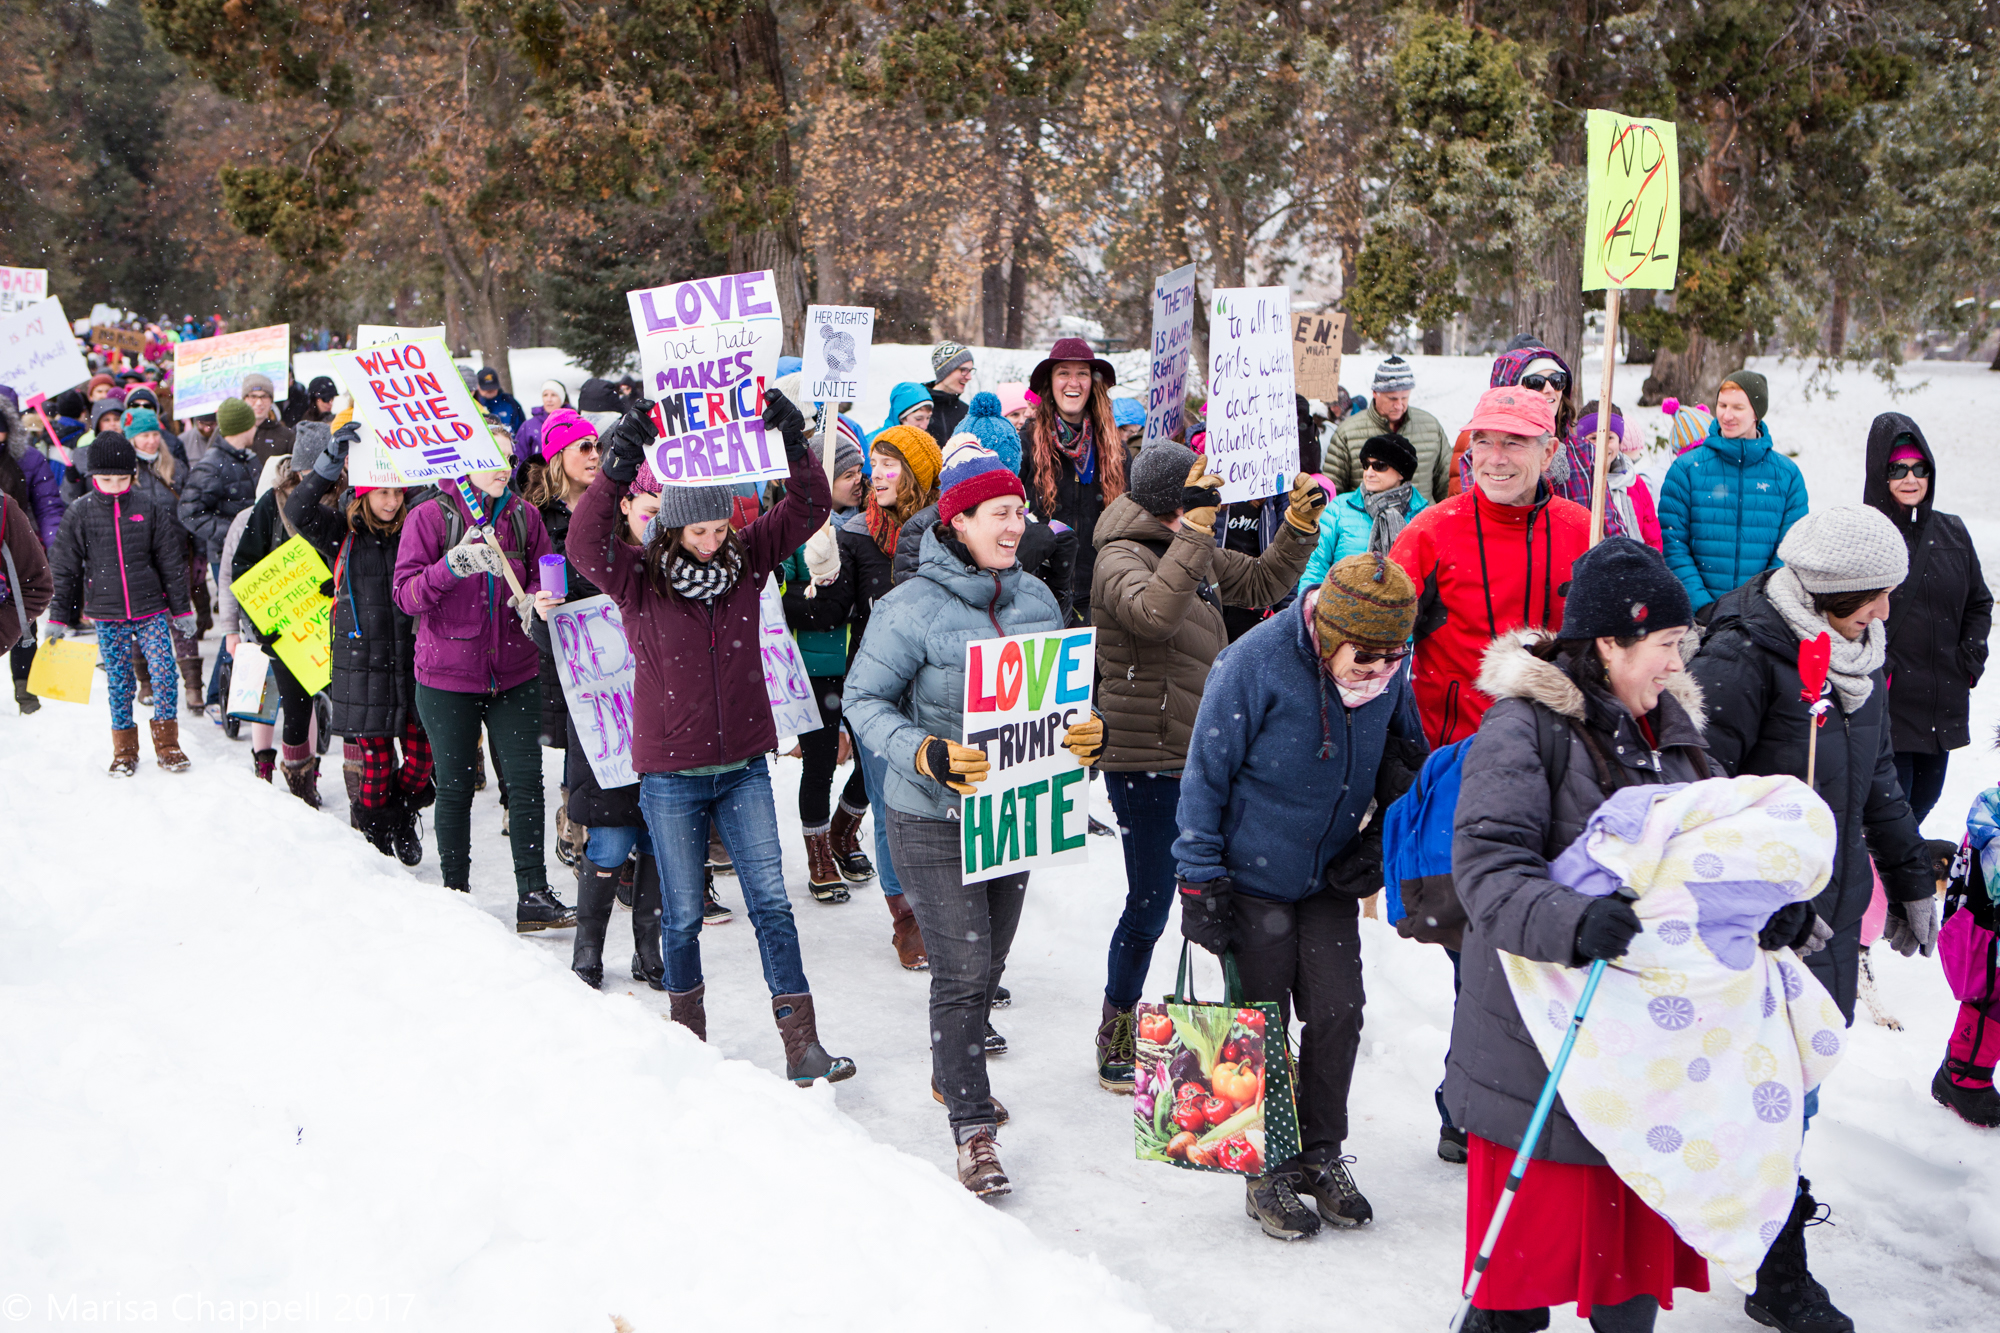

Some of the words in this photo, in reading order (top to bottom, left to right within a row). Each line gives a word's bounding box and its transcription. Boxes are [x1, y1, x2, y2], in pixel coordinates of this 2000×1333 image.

[1607, 119, 1662, 178] NO
[639, 271, 773, 332] LOVE
[1181, 283, 1195, 308] TIM
[814, 310, 832, 325] HER
[834, 310, 869, 325] RIGHTS
[1251, 299, 1267, 334] all
[1294, 315, 1339, 345] EN:
[664, 335, 705, 360] not
[716, 327, 762, 352] hate
[1179, 346, 1188, 368] TO
[1306, 345, 1332, 356] WHAT
[201, 351, 257, 373] EQUALITY
[355, 345, 426, 376] WHO
[656, 351, 753, 391] MAKES
[1213, 346, 1251, 396] girls
[204, 374, 227, 390] FOR
[369, 372, 443, 403] RUN
[813, 381, 857, 398] UNITE
[1149, 385, 1165, 412] DO
[379, 396, 458, 425] THE
[646, 376, 770, 438] AMERICA
[375, 421, 474, 449] WORLD
[656, 419, 772, 480] GREAT
[1208, 422, 1256, 456] Valuable
[405, 463, 461, 478] EQUALITY
[463, 459, 475, 470] 4
[477, 458, 501, 469] ALL
[237, 564, 281, 602] WOMEN
[282, 543, 307, 568] ARE
[249, 594, 269, 611] IN
[269, 561, 313, 596] CHARGE
[267, 600, 285, 618] OF
[284, 575, 322, 604] THEIR
[292, 605, 330, 643] LOVE
[315, 628, 328, 640] IS
[967, 633, 1093, 713] LOVE
[967, 709, 1078, 771] TRUMPS
[965, 767, 1086, 875] HATE
